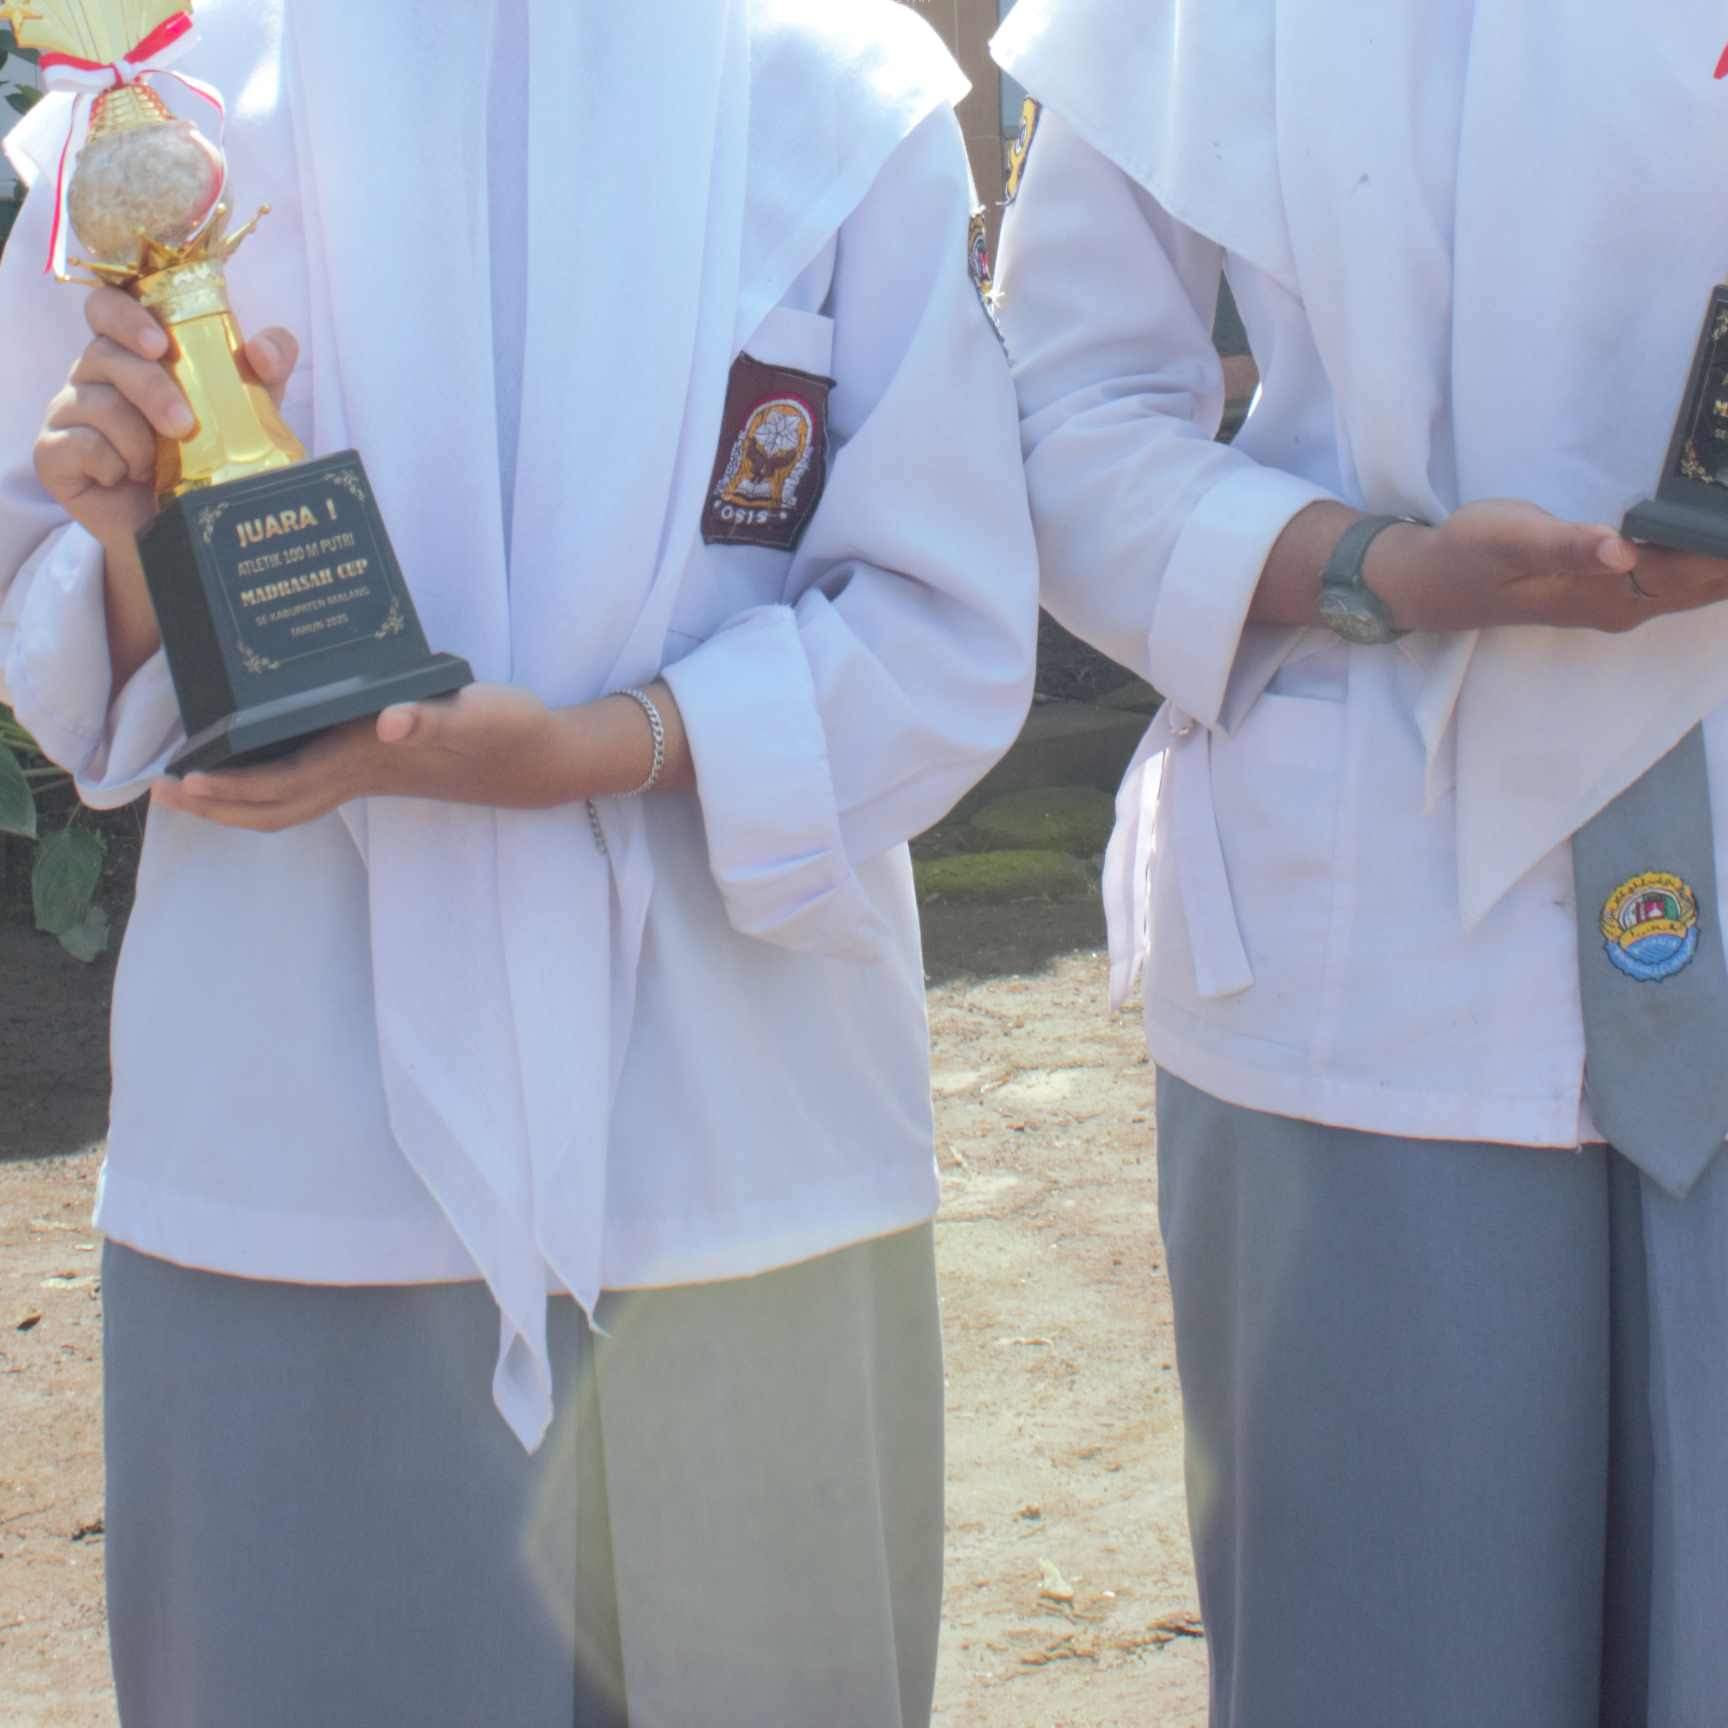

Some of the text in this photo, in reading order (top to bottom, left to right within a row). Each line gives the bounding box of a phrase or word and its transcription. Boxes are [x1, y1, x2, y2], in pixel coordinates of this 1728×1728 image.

[235, 504, 318, 547] JUARA
[721, 507, 769, 524] OSIS
[237, 532, 354, 576] ATLETIK 100 M PUTRI
[239, 558, 369, 608] MADRASAH CUP
